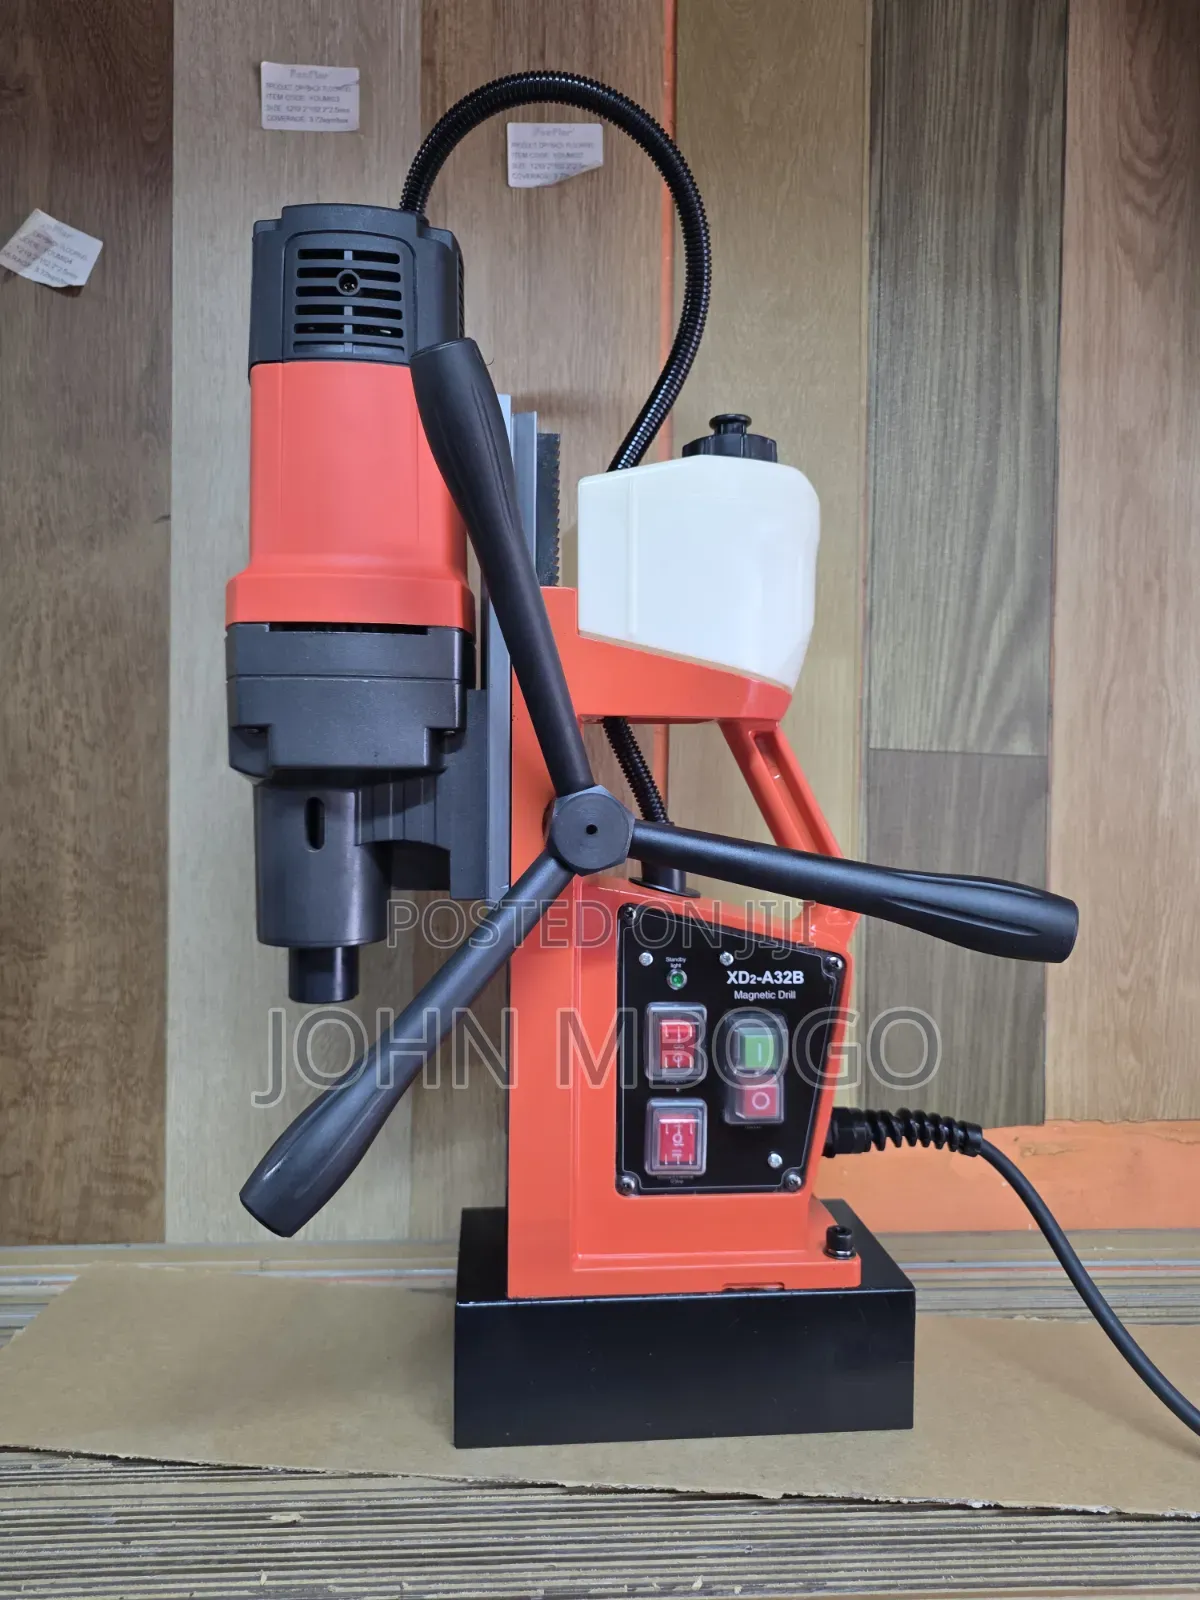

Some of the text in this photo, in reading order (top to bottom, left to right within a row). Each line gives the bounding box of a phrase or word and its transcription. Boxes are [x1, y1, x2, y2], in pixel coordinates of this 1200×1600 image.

[665, 956, 687, 964] Standby
[734, 990, 796, 1001] Magnetic Drill
